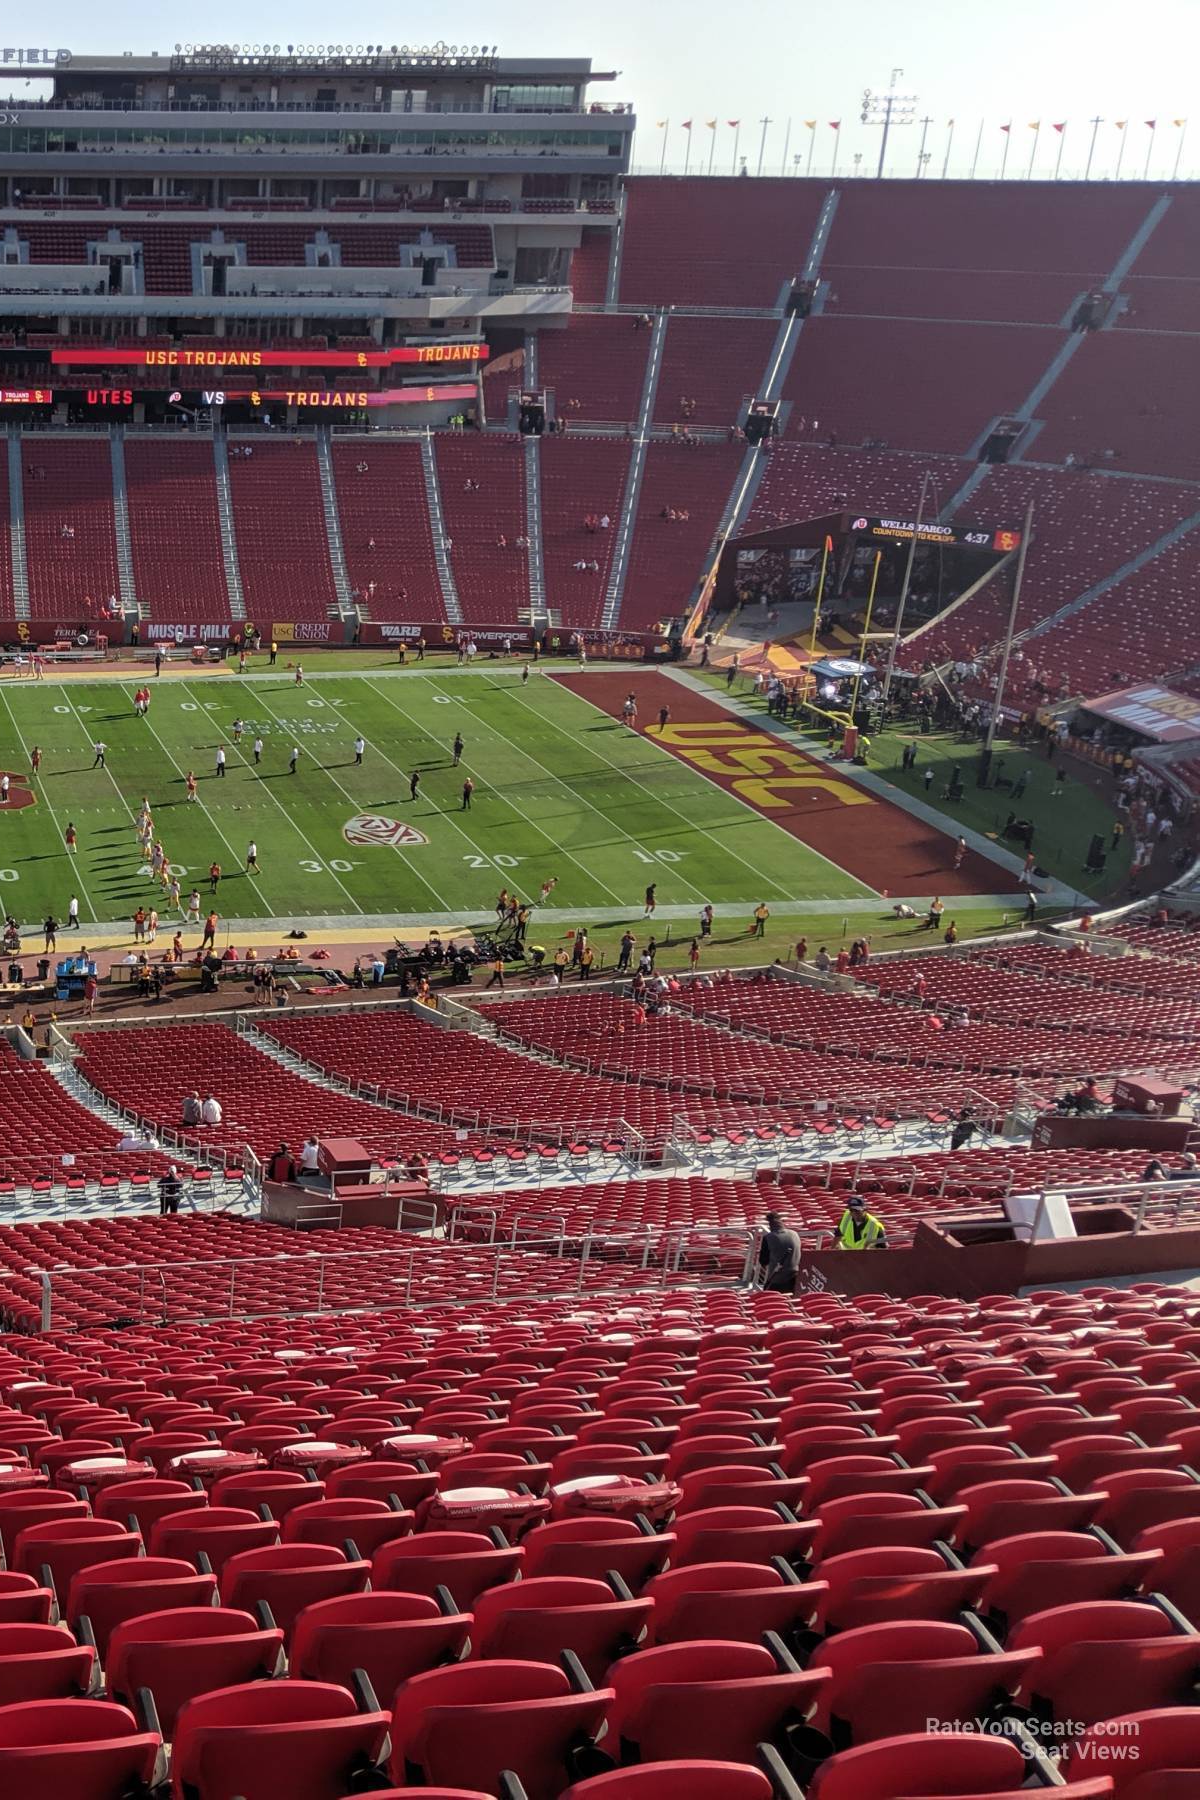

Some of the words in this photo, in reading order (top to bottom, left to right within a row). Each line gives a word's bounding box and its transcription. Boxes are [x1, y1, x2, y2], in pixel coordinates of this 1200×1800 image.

[3, 48, 73, 64] FIELD
[146, 351, 178, 365] USC
[184, 351, 262, 366] TROJANS
[417, 345, 480, 362] TROJANS
[87, 390, 133, 405] UTES
[204, 391, 225, 404] VS
[286, 392, 368, 407] TROJANS
[880, 519, 915, 531] WELLS
[917, 523, 952, 535] FARGO
[872, 527, 915, 539] COUNTDOWN
[917, 532, 926, 540] TO
[926, 533, 957, 543] KICKOFF
[965, 532, 990, 545] 4:37
[148, 624, 197, 639] MUSCLE
[200, 624, 230, 639] MILK
[273, 626, 293, 637] USC
[294, 623, 332, 632] CREDIT
[294, 630, 330, 640] UNION
[381, 625, 422, 637] WARE
[644, 721, 875, 808] USC
[462, 854, 519, 868] 20
[631, 849, 682, 863] 10
[299, 859, 354, 873] 30
